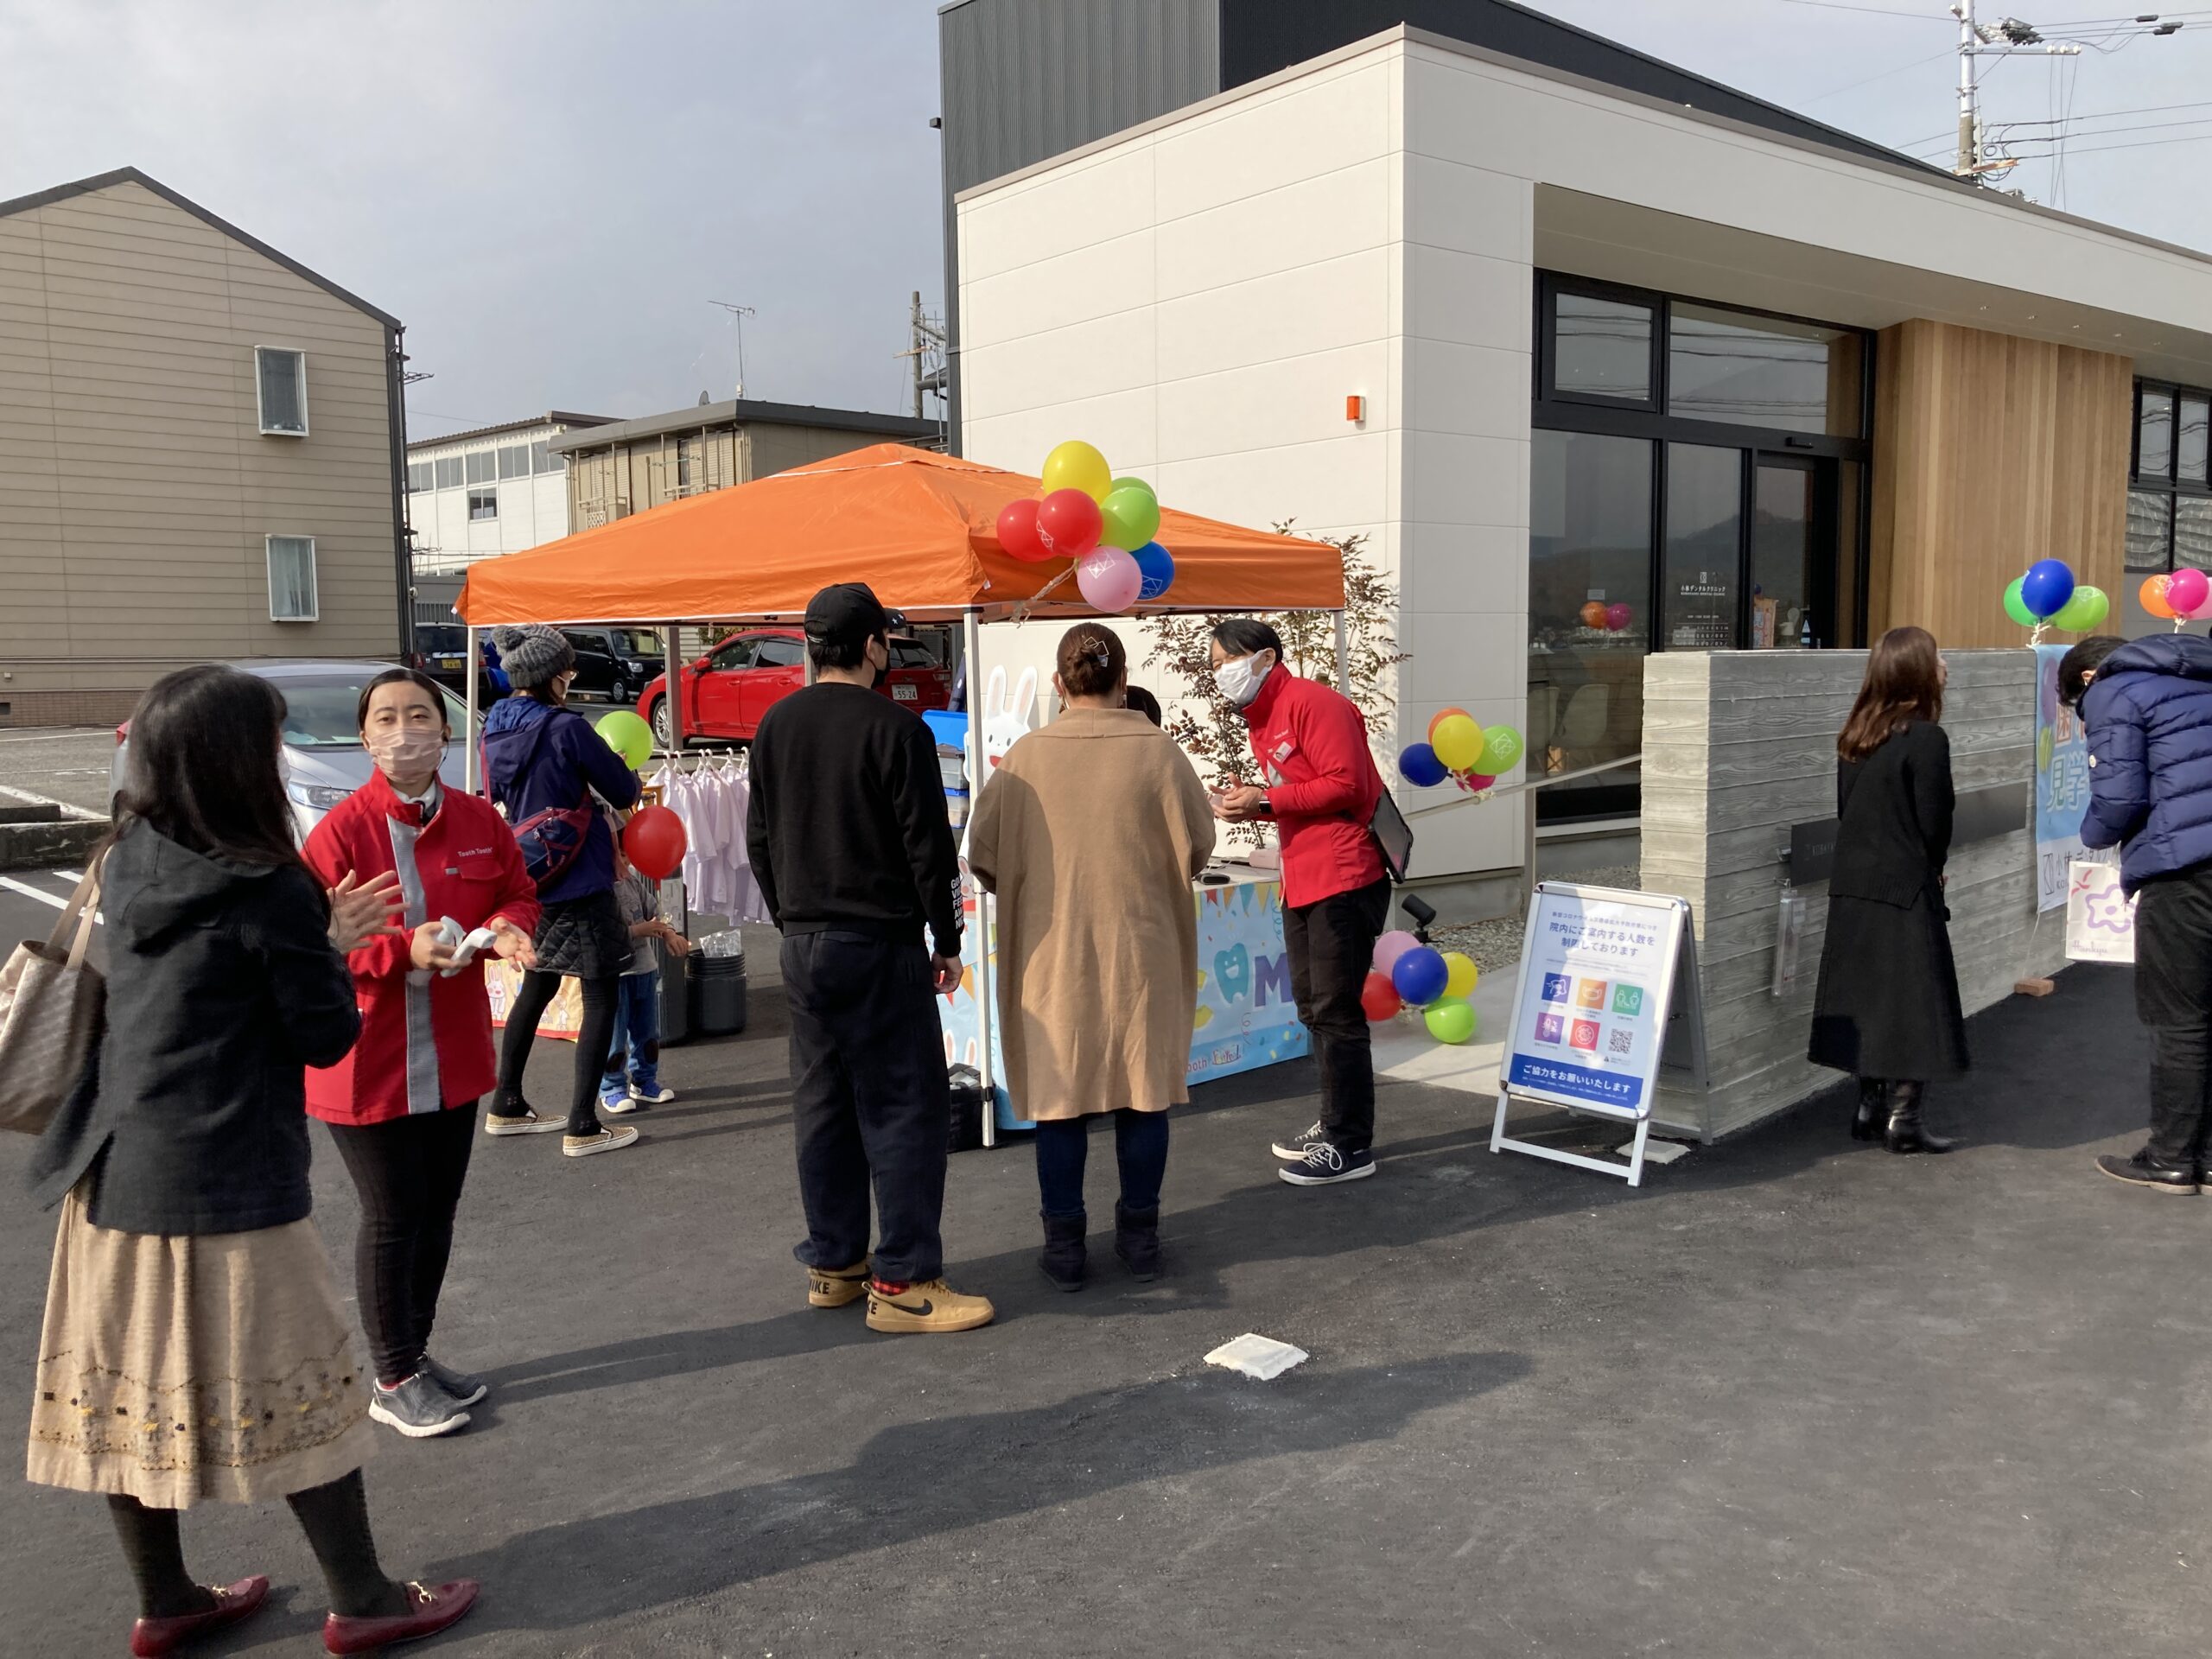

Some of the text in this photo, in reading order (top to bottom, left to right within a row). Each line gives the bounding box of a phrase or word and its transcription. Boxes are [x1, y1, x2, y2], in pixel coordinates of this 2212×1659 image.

[2047, 749, 2089, 813] 見学
[1548, 921, 1656, 947] 院内にご案内する人数を
[1186, 1058, 1207, 1072] ooth
[1522, 1064, 1631, 1094] ご協力をお願いいたします
